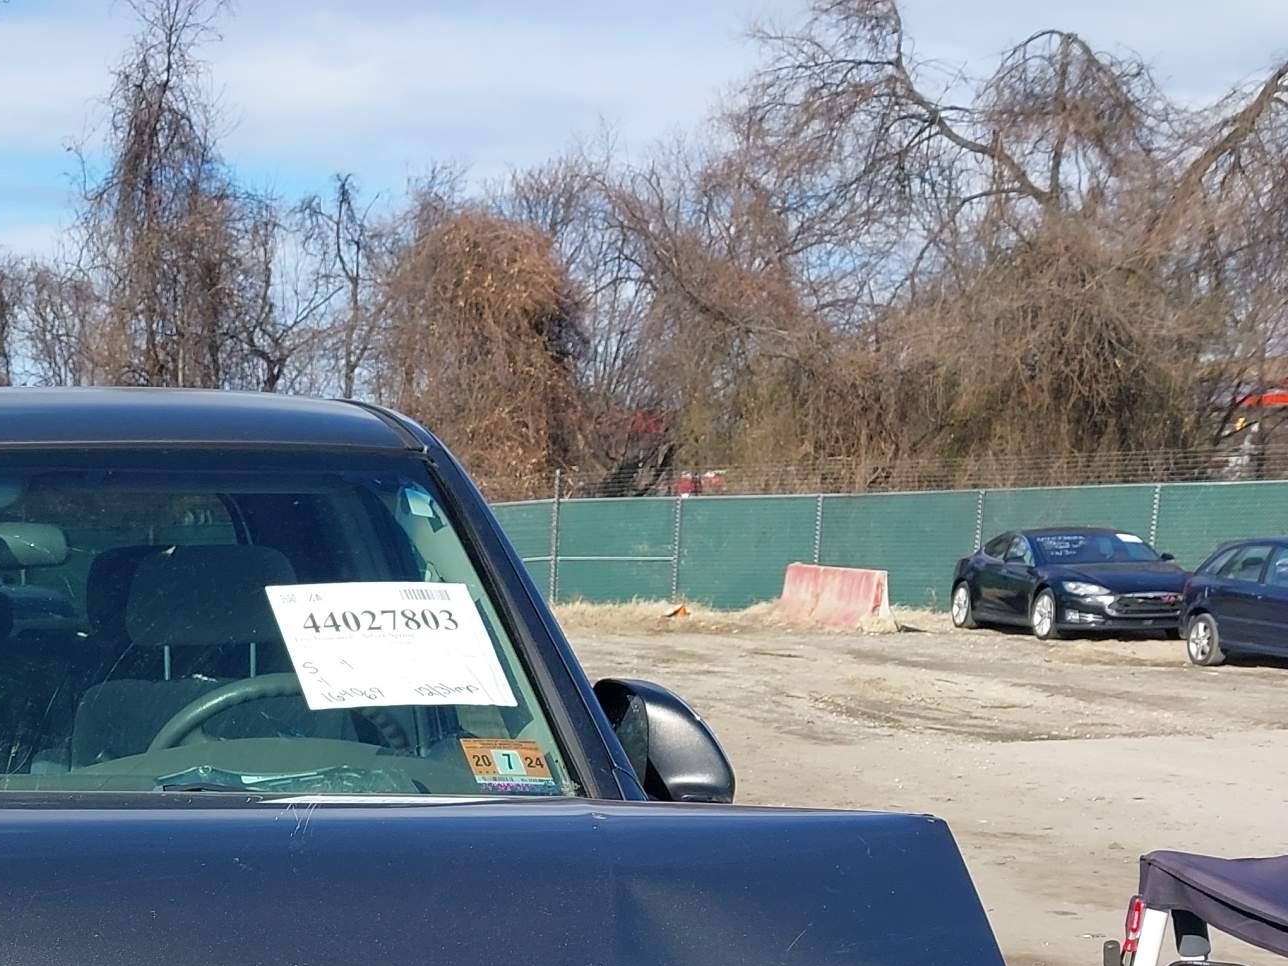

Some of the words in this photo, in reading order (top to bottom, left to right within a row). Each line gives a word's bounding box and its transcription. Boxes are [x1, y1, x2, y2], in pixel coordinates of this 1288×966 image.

[303, 609, 459, 633] 44027803
[472, 754, 492, 767] 20
[501, 753, 513, 770] 7
[524, 756, 544, 769] 24
